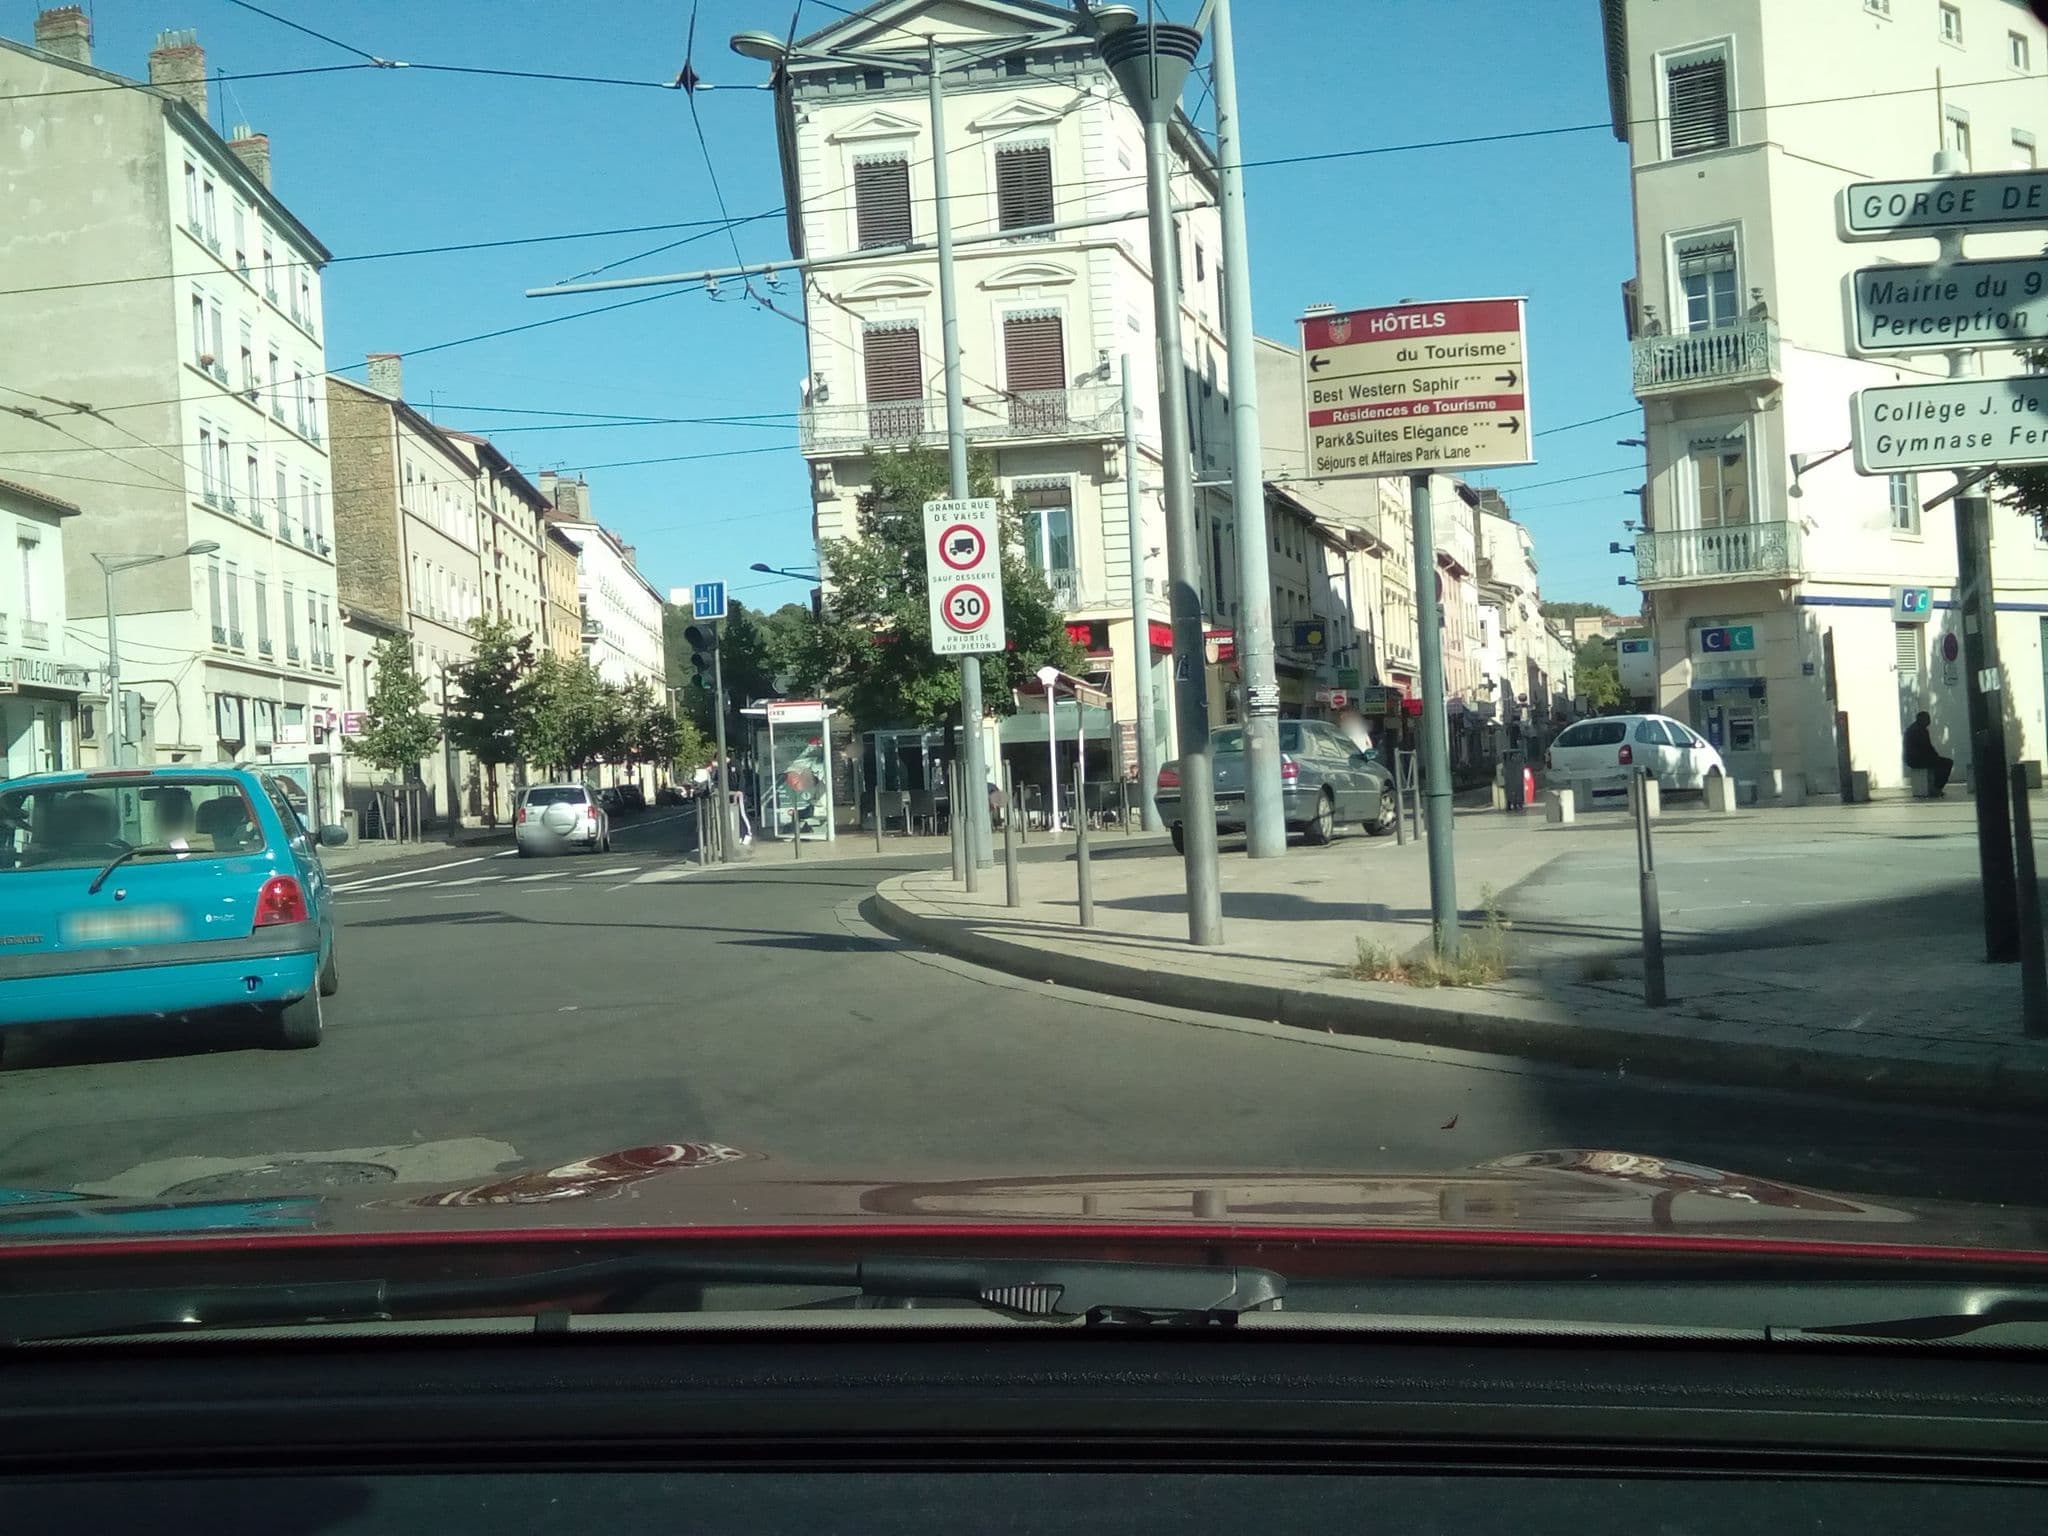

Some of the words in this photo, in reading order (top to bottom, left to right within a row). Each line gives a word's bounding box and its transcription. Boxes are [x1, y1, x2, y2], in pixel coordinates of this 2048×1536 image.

[1864, 189, 1976, 218] GORGE
[2002, 185, 2042, 210] DE
[1869, 281, 1959, 305] Mairie
[1975, 275, 2007, 298] du
[1370, 312, 1446, 333] HÔTELS
[1872, 307, 2028, 338] Perception
[1396, 346, 1418, 362] du
[1425, 342, 1506, 360] Tourisme
[1313, 388, 1343, 404] Best
[1349, 383, 1406, 400] Western
[1412, 377, 1460, 395] Saphir
[1333, 406, 1408, 422] Résidences
[1413, 402, 1429, 415] de
[1433, 399, 1497, 414] Tourisme
[1874, 400, 1966, 423] Collège
[1980, 396, 1998, 415] J.
[2012, 394, 2038, 413] de
[1315, 427, 1399, 449] Park&Suites
[1876, 433, 1992, 456] Gymnase
[1316, 456, 1356, 472] Séjours
[1358, 453, 1370, 466] et
[1371, 449, 1412, 465] Affaires
[1416, 446, 1440, 461] Park
[1444, 444, 1470, 458] Lane
[928, 502, 967, 512] GRANDE
[970, 500, 990, 510] RUE
[934, 514, 948, 522] DE
[953, 511, 986, 521] VAISE
[955, 572, 996, 581] DESSERTE
[954, 598, 980, 617] 30
